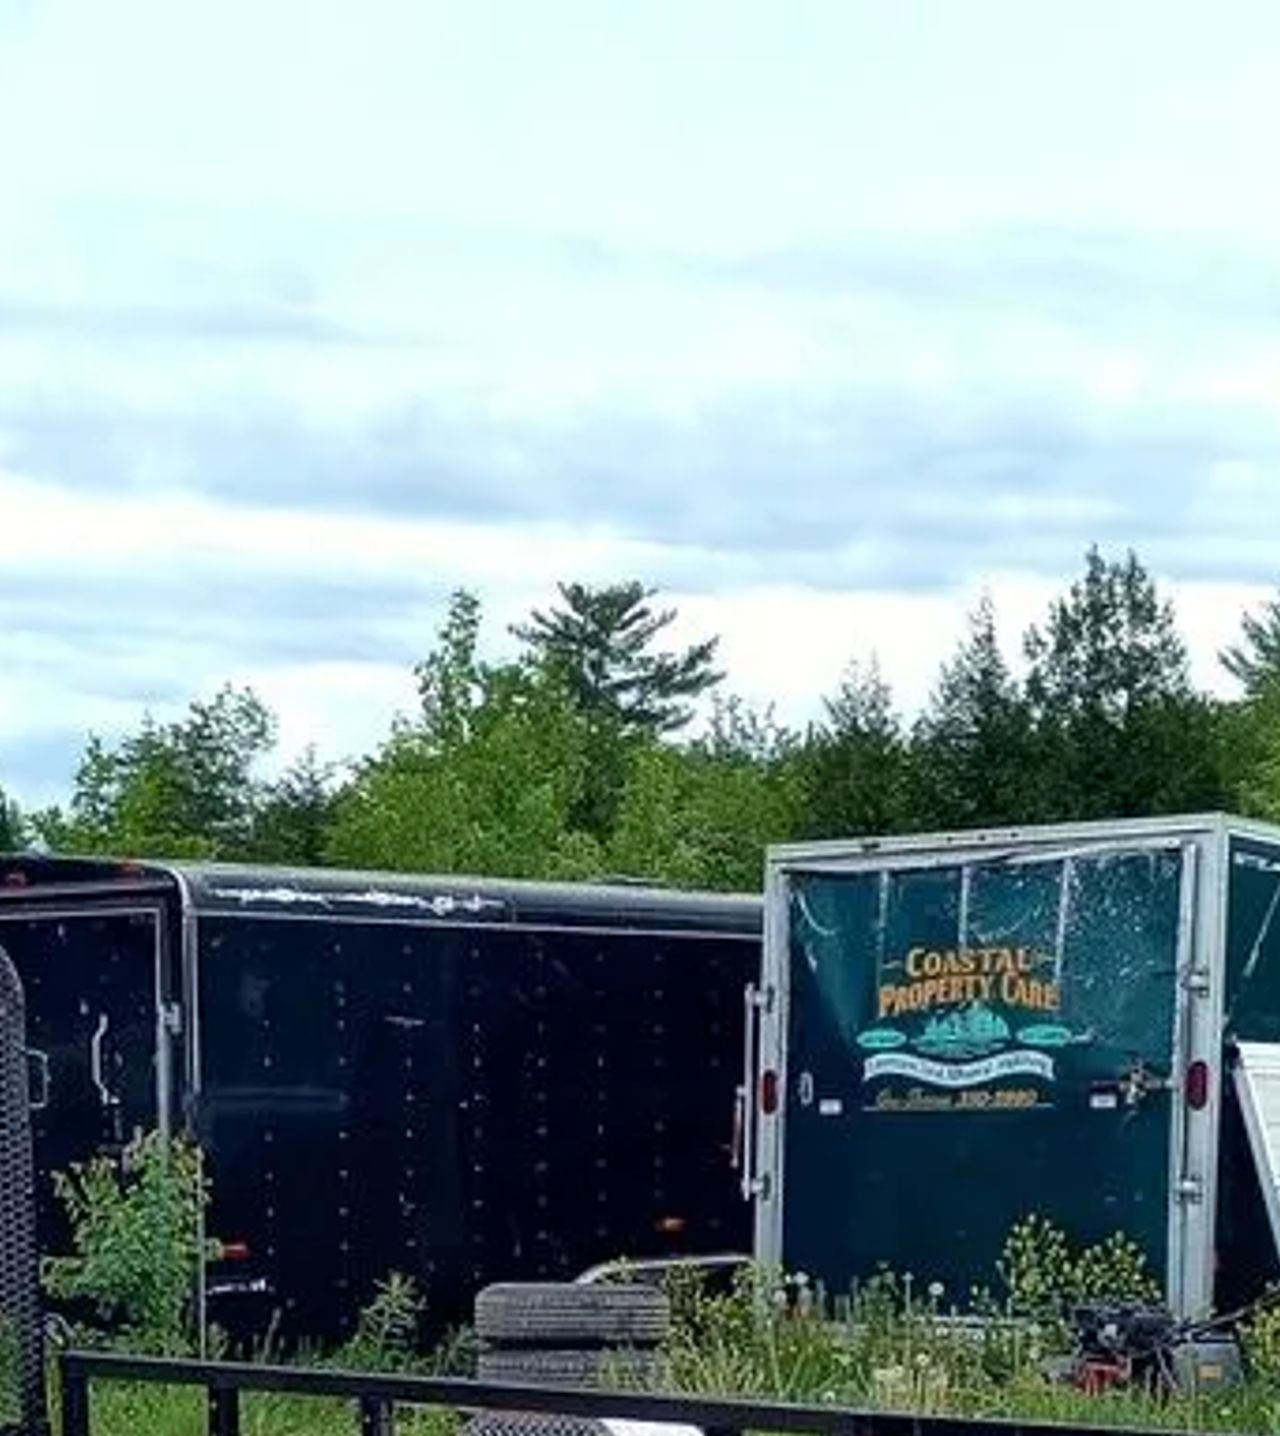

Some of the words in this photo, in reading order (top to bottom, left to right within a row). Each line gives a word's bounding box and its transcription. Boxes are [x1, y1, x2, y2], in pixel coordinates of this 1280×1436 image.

[905, 946, 1032, 977] COASTAL
[878, 976, 994, 1018] PROPERTY
[1000, 972, 1061, 1012] CARE
